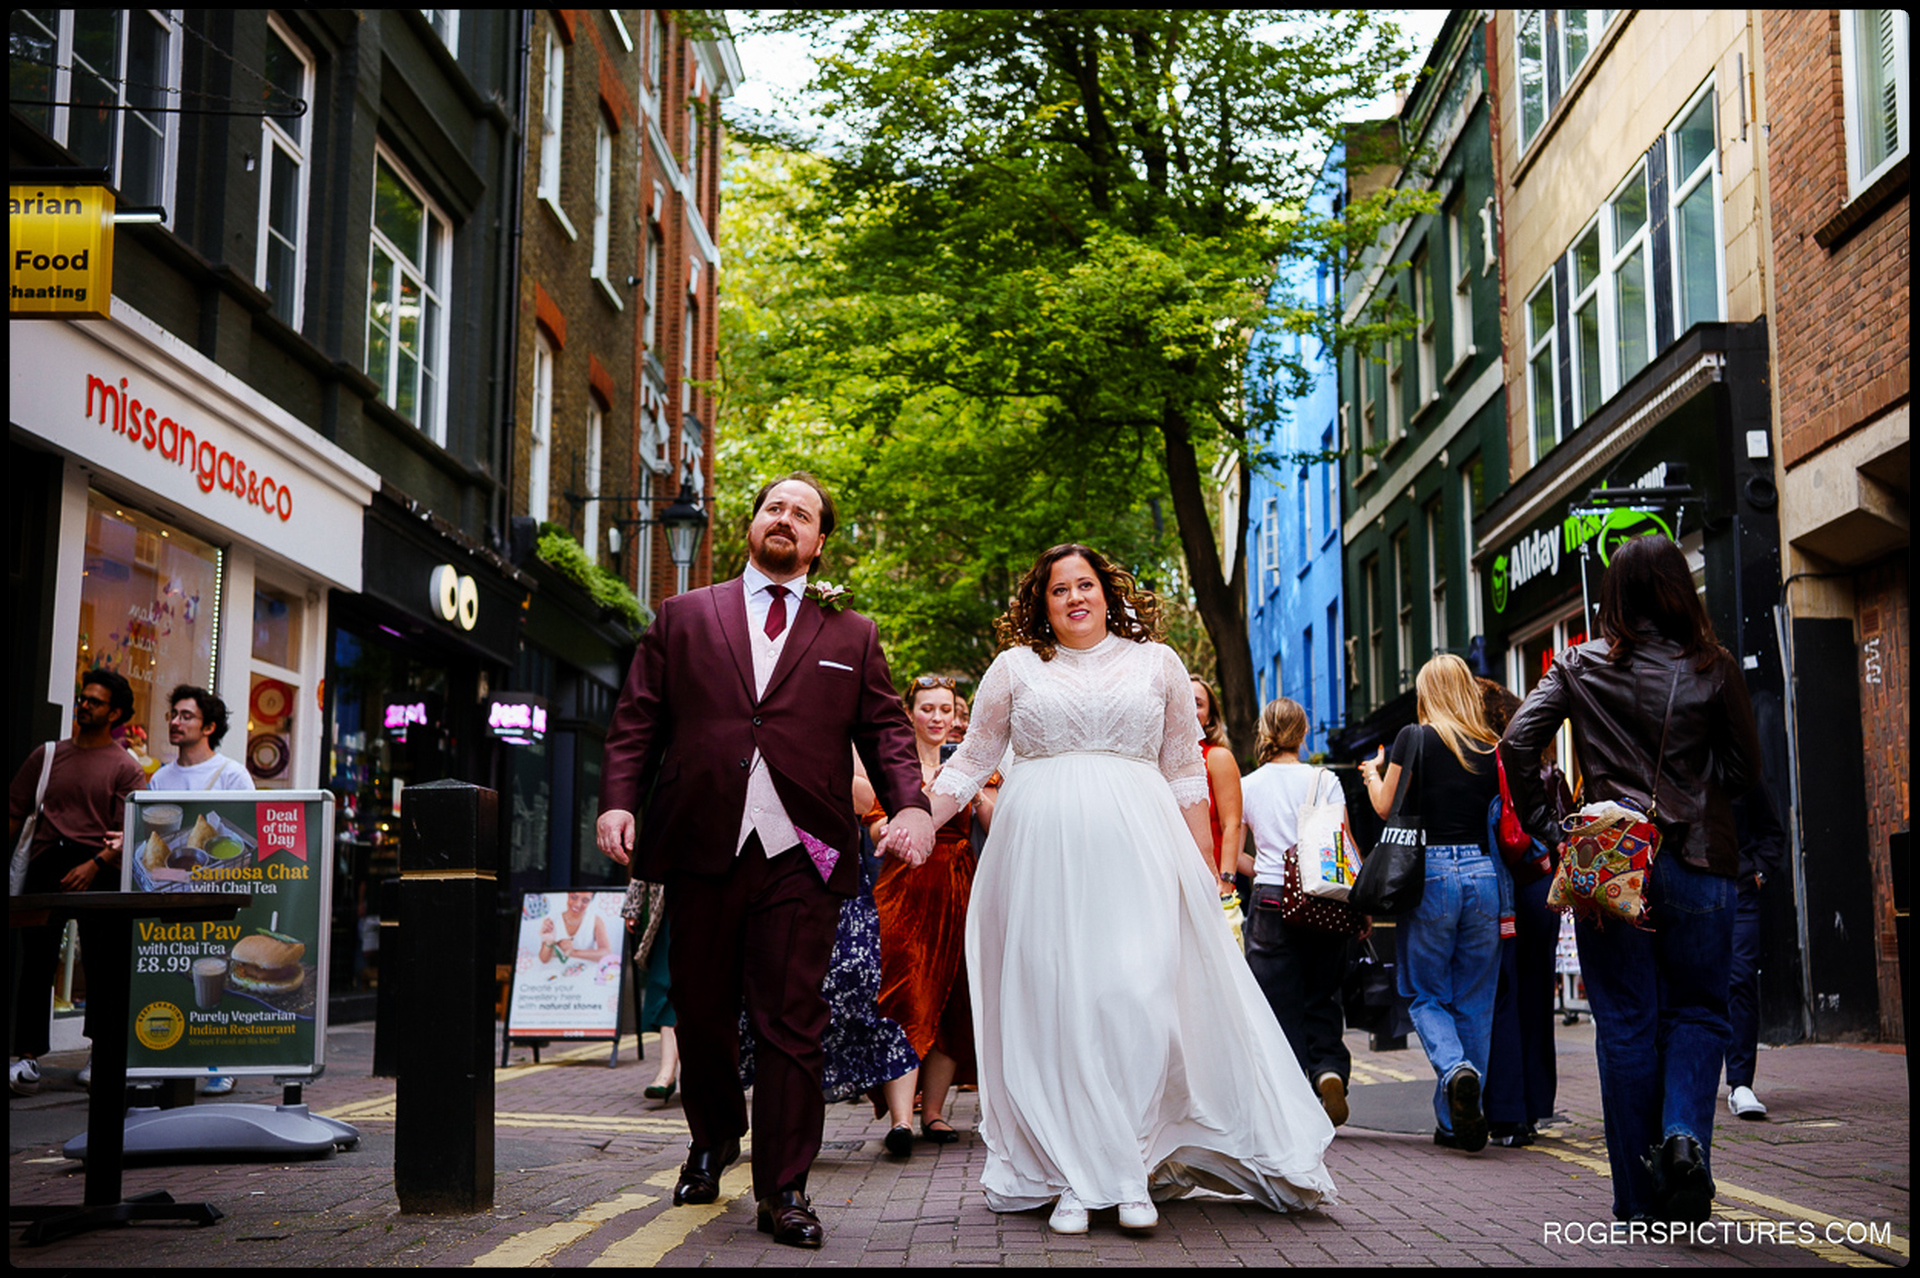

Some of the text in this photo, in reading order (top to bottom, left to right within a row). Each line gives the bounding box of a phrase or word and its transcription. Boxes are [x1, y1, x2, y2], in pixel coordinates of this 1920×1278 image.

[15, 249, 89, 271] Food
[10, 285, 87, 302] haating
[86, 373, 293, 521] missangas&co
[1510, 524, 1561, 592] Allday
[266, 808, 298, 821] Deal
[262, 822, 298, 834] of the
[267, 833, 295, 849] Day
[1376, 827, 1418, 847] ITTERS
[190, 863, 309, 880] Samosa Chat
[190, 881, 278, 894] with Chai Tea
[139, 921, 242, 941] Vada Pav
[137, 941, 226, 956] with Chai Tea
[136, 956, 191, 973] £8.99
[539, 1002, 571, 1010] natural
[189, 1010, 296, 1024] Purely Vegetarian
[189, 1024, 296, 1036] Indian Restaurant
